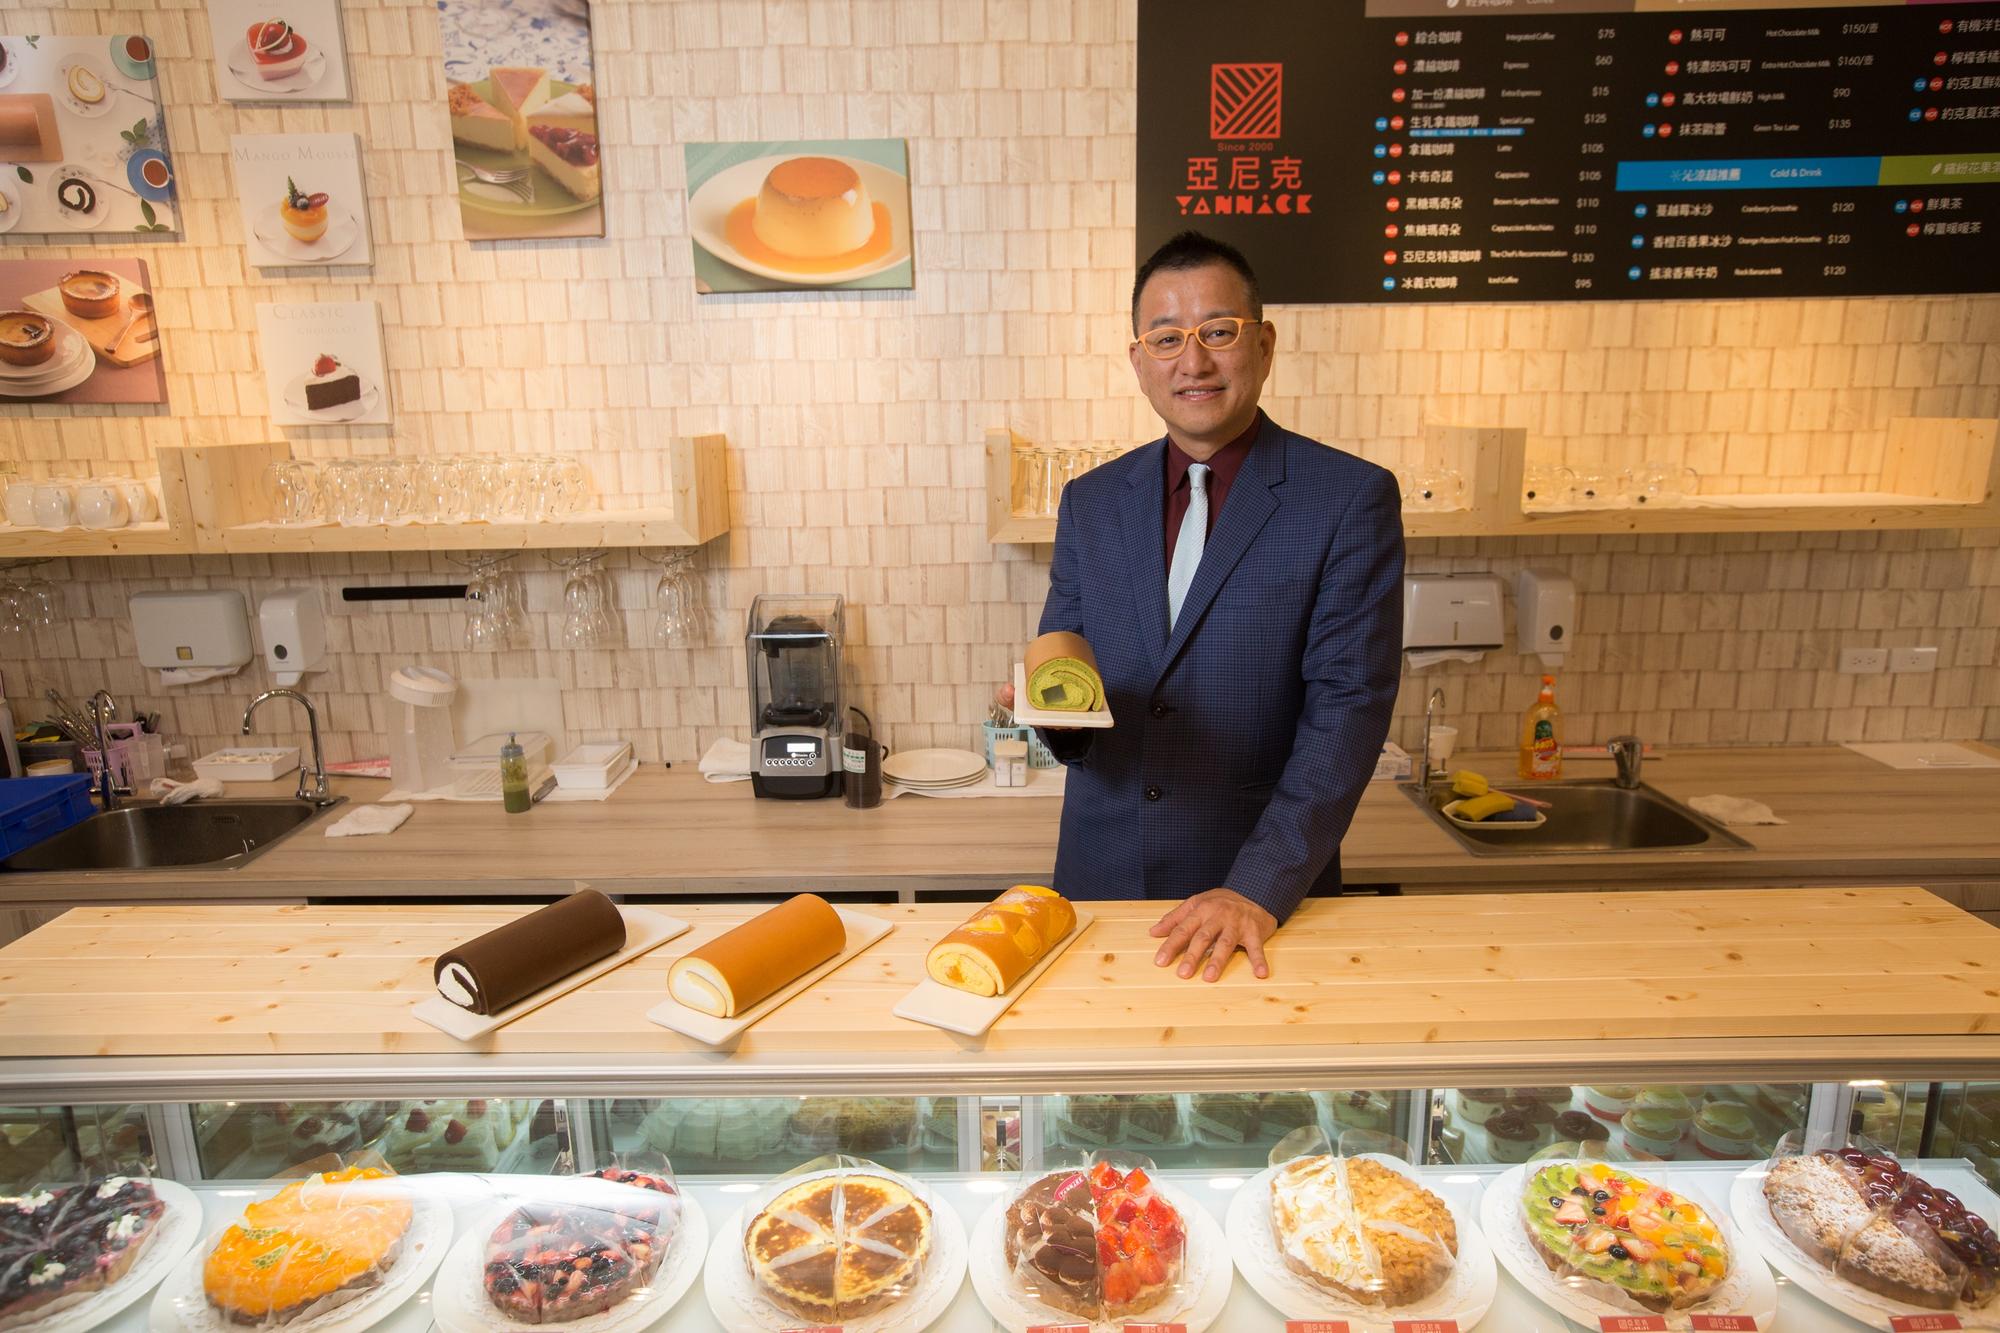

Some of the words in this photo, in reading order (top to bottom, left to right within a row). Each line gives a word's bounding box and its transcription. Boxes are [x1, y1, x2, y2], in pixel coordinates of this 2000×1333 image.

[1598, 29, 1615, 40] $75
[1690, 28, 1726, 42] 熱可可
[1595, 55, 1613, 66] $60
[1592, 86, 1610, 97] $15
[1833, 88, 1850, 98] $90
[1585, 114, 1607, 125] $125
[1829, 119, 1851, 129] $135
[1217, 142, 1245, 152] Since
[1249, 142, 1274, 151] 2000
[1582, 143, 1604, 154] $105
[1186, 155, 1303, 190] 亞尼克
[1407, 170, 1453, 183] 卡布奇諾
[1579, 170, 1601, 182] $105
[1770, 169, 1789, 178] Cold
[1791, 169, 1798, 177] &
[1799, 168, 1822, 177] Drink
[1175, 194, 1313, 215] YANNICK
[1576, 198, 1599, 209] $110
[1832, 203, 1854, 213] $120
[1574, 225, 1597, 236] $110
[1828, 234, 1850, 244] $120
[1402, 250, 1482, 264] 亞尼克特選咖啡
[1572, 252, 1594, 263] $130
[1823, 265, 1846, 276] $120
[1575, 279, 1592, 290] $95
